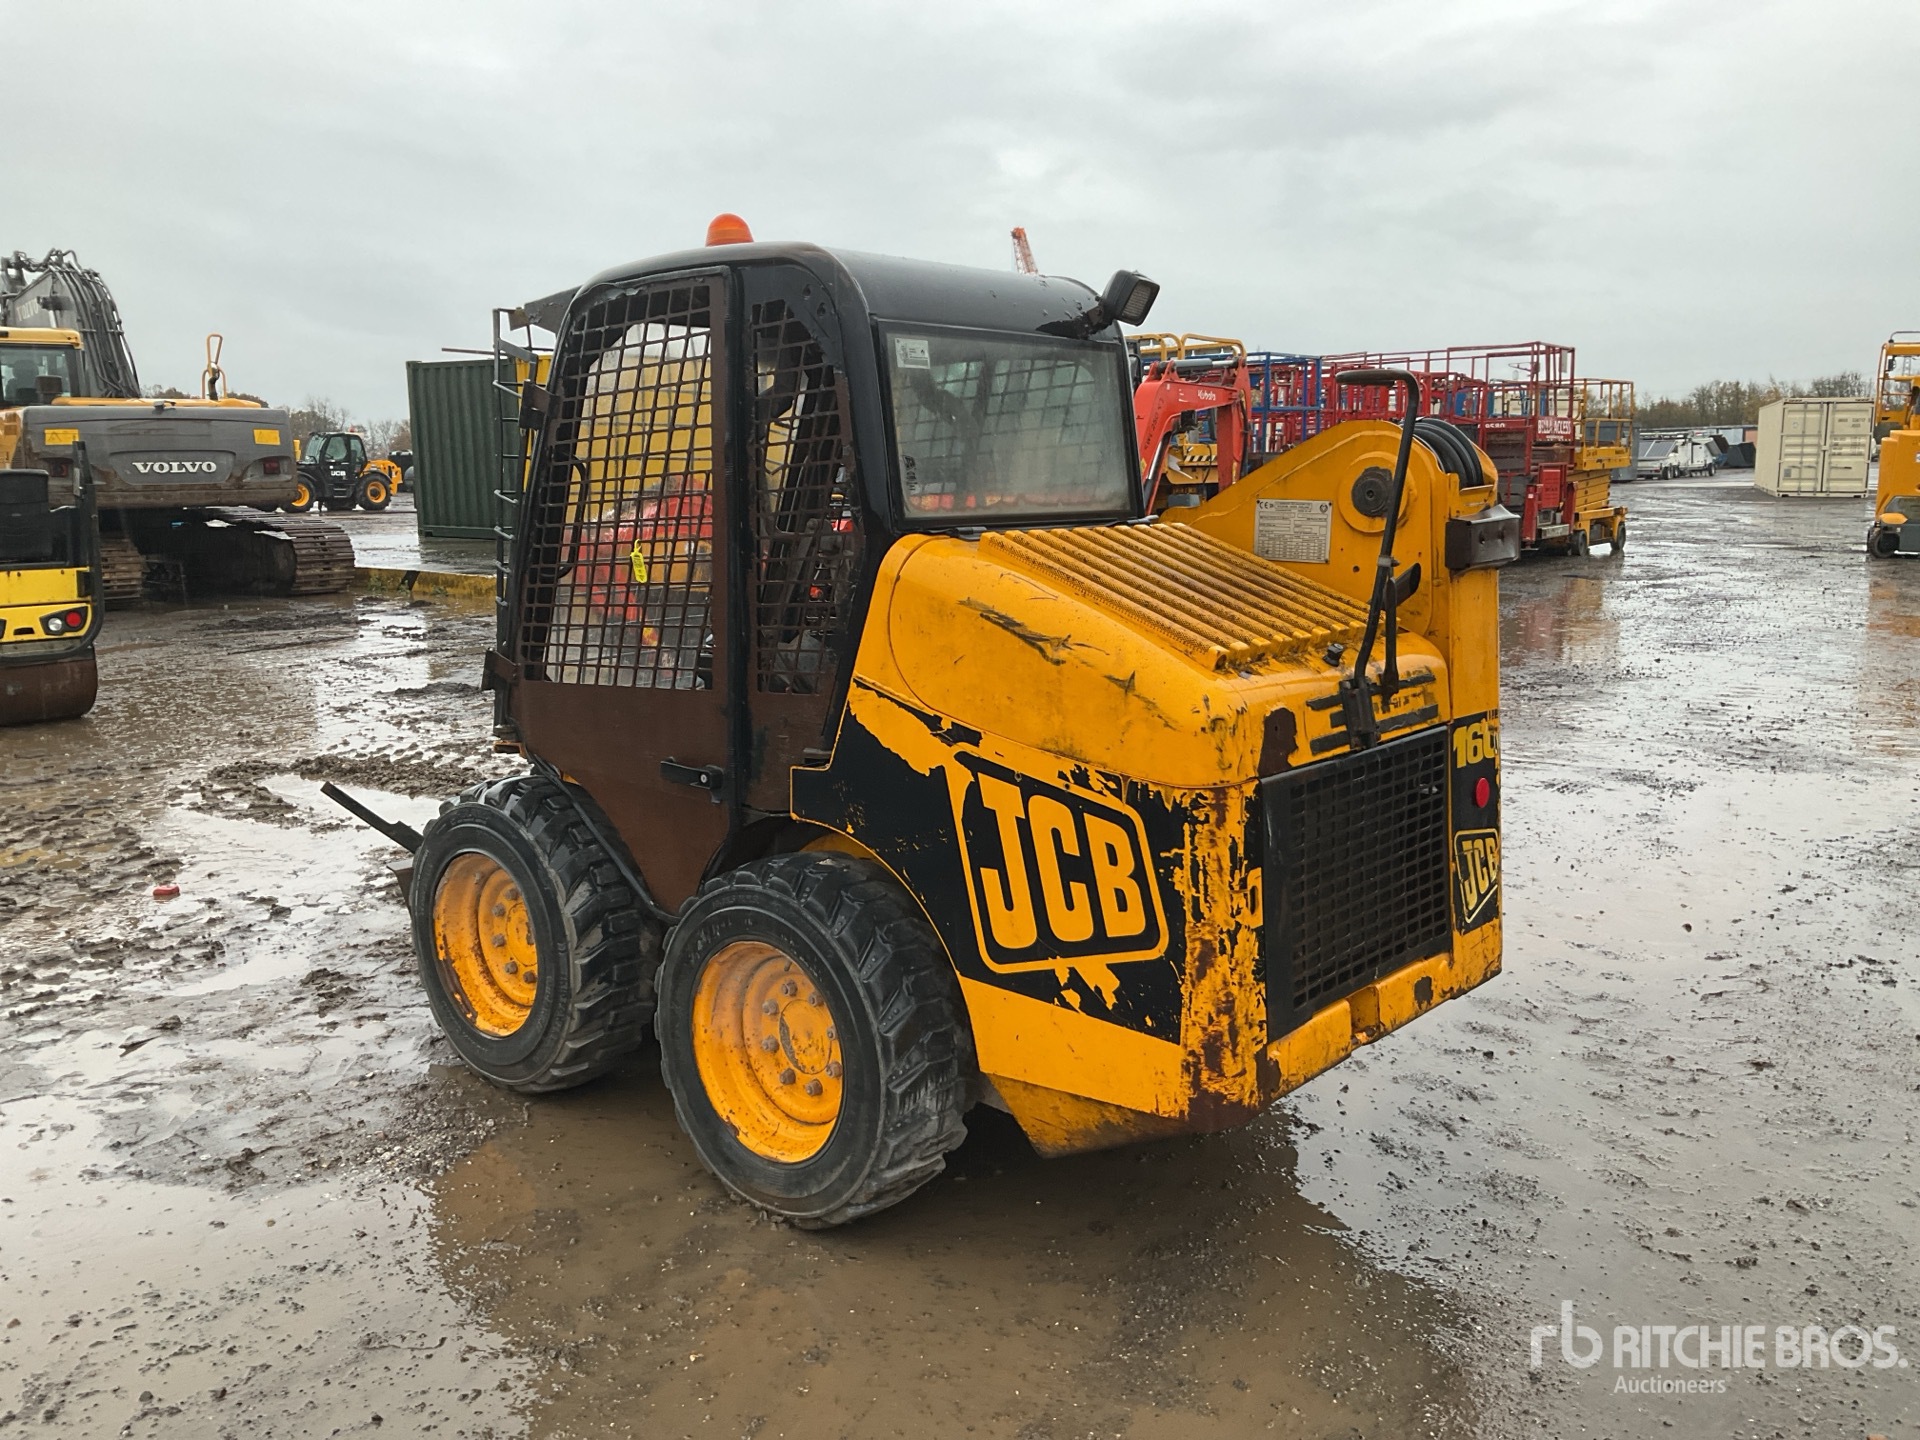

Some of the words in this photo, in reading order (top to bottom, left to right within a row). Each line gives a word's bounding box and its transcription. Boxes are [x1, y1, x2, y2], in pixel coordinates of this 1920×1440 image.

[132, 461, 217, 474] VOLVO
[977, 771, 1146, 949] JCB
[1461, 837, 1498, 911] JCB
